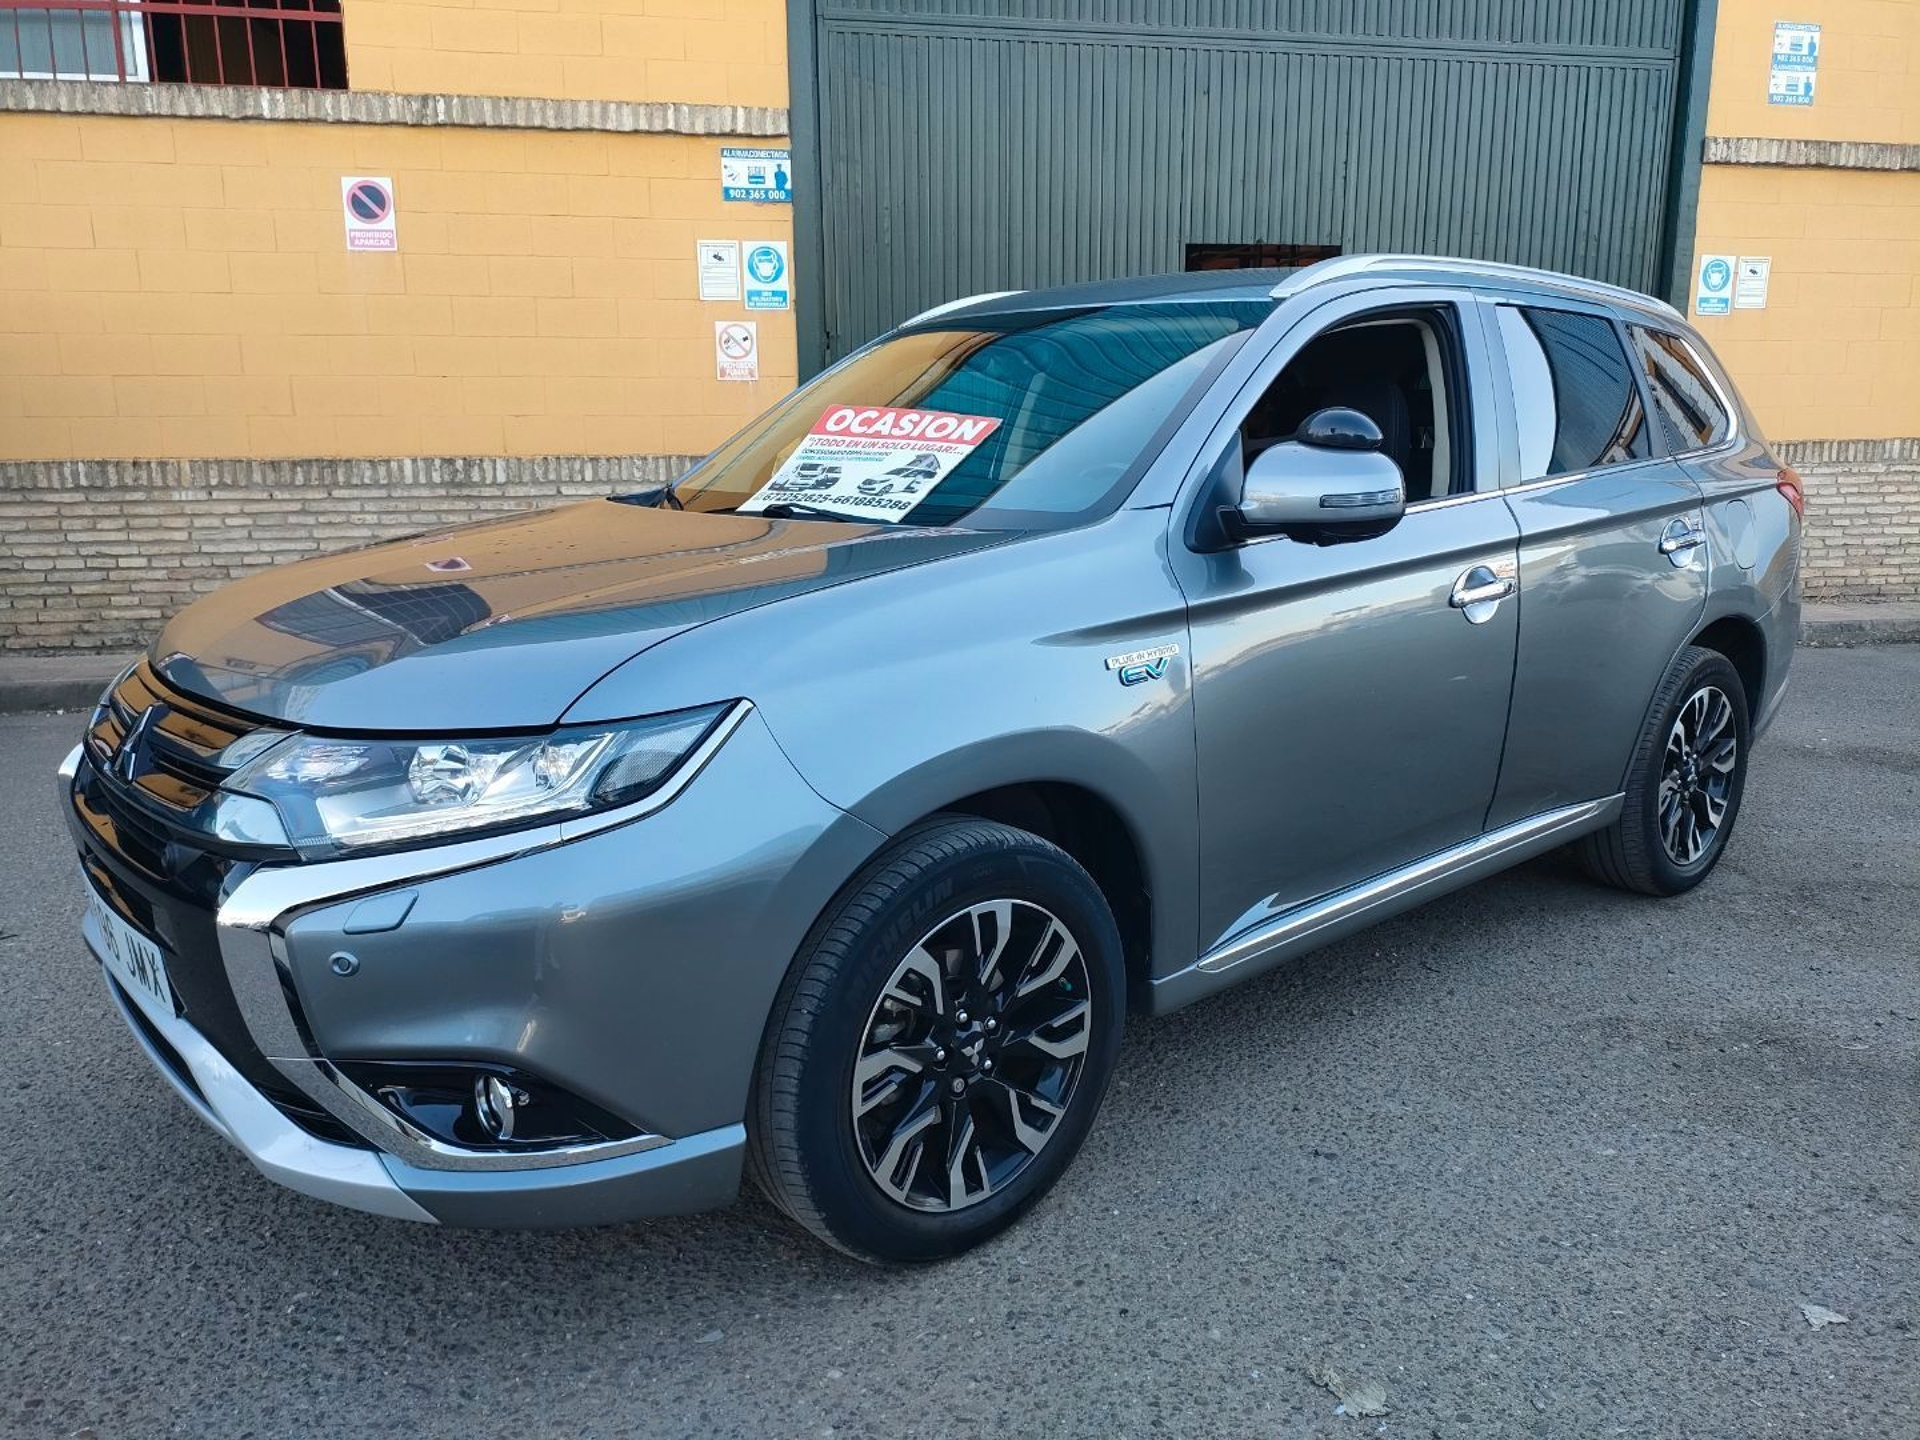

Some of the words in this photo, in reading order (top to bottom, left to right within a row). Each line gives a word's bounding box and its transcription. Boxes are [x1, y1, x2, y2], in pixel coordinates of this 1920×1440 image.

[729, 189, 746, 198] 902
[749, 190, 766, 199] 365
[768, 190, 786, 199] 000
[825, 408, 987, 441] OCASION
[845, 440, 862, 448] EN
[862, 441, 877, 449] UN
[877, 442, 911, 450] SOLO
[1111, 652, 1145, 667] PLUG-IN
[1146, 645, 1177, 660] HYBRID
[1119, 657, 1170, 687] EV
[124, 931, 167, 1003] JMX
